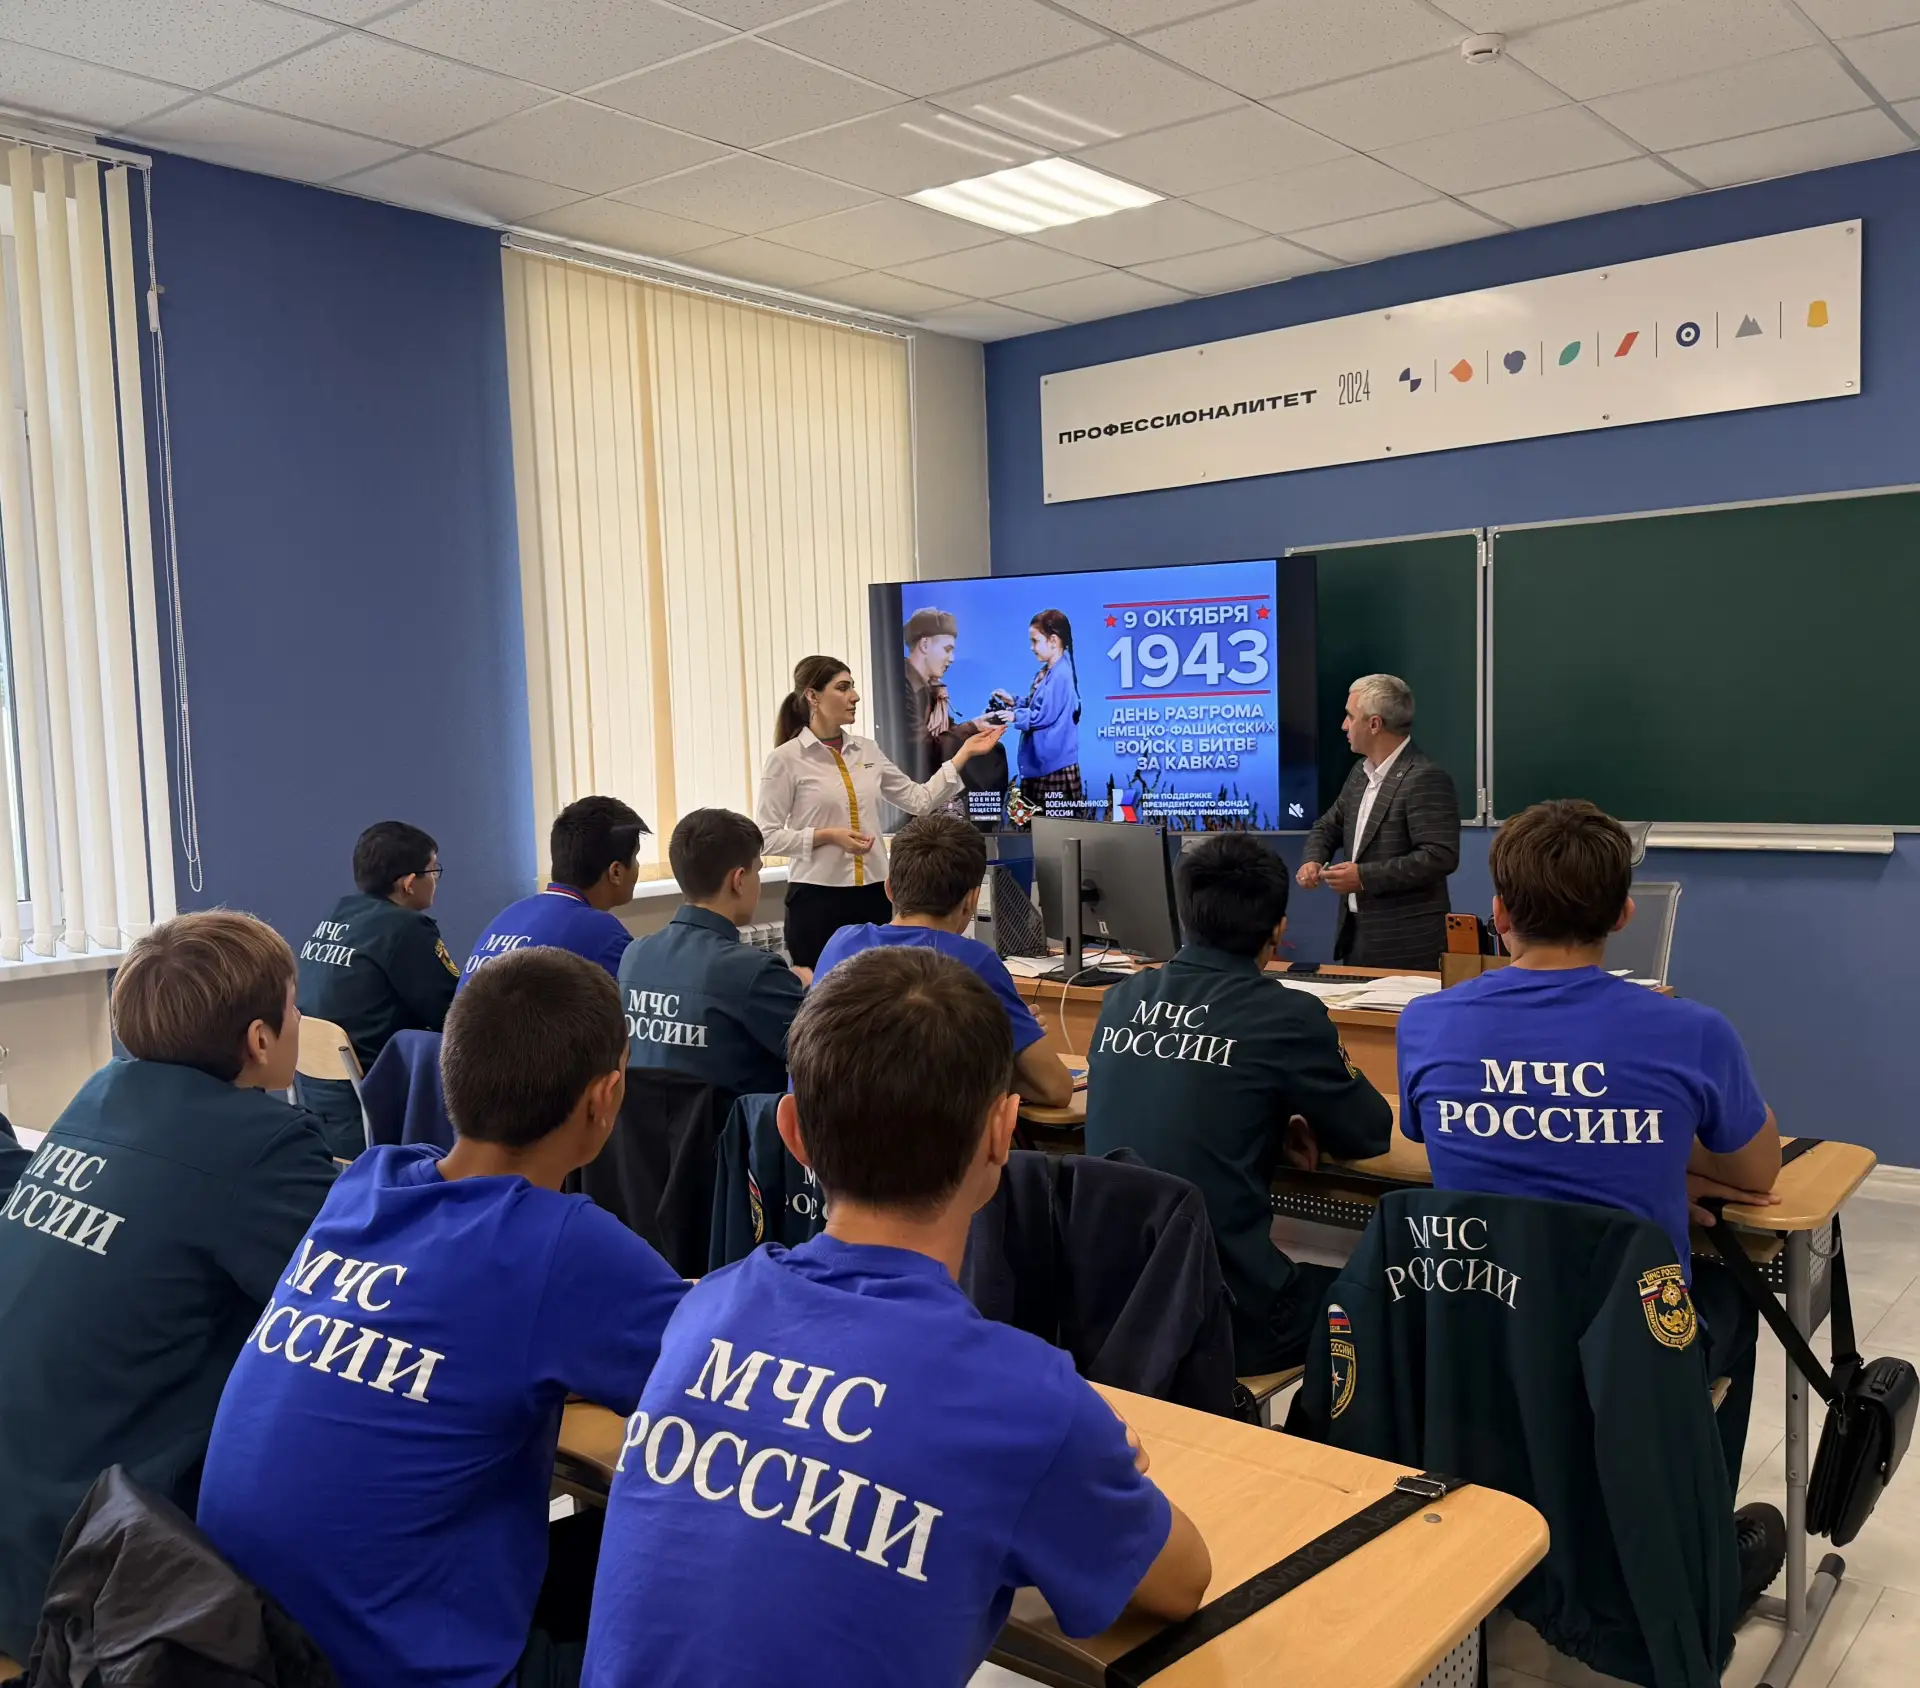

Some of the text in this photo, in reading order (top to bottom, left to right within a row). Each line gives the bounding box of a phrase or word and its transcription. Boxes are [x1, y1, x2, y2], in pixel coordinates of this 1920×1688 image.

[1058, 369, 1371, 445] ПРОФЕССИОНАЛИТЕТ 2024
[1123, 604, 1249, 628] 9 ОКТЯБРЯ
[1106, 629, 1269, 689] 1943
[1111, 704, 1264, 725] ДЕНЬ РАЗГРОМА
[1097, 720, 1276, 739] НЕМЕЦКО-ФАШИСТСКИХ
[1114, 736, 1257, 755] ВОЙСК В БИТВЕ
[1136, 754, 1239, 771] ЗА КАВКАЗ
[1045, 791, 1064, 799] КЛУБ
[1045, 799, 1109, 808] ВОЕНАЧАЛЬНИКОВ
[1142, 799, 1249, 808] ПРЕЗИДЕНТСКОГО ФОНДА
[1160, 792, 1213, 800] ПОДДЕРЖКЕ
[1045, 808, 1074, 817] РОССИИ
[1142, 808, 1250, 817] КУЛЬТУРНЫХ ИНИЦИАТИВ
[312, 920, 350, 942] МЧС
[480, 934, 532, 952] МЧС
[300, 940, 357, 968] ОССИИ
[628, 989, 680, 1018] МЧС
[1130, 1000, 1209, 1029] МЧС
[625, 1014, 708, 1048] ОССИИ
[1098, 1026, 1237, 1068] РОССИИ
[1480, 1058, 1608, 1098] МЧС
[1436, 1100, 1664, 1144] РОССИИ
[25, 1142, 108, 1192] МЧС
[0, 1179, 126, 1256] ОССИИ
[1404, 1215, 1488, 1251] МЧС
[285, 1238, 407, 1312] МЧС
[247, 1297, 445, 1403] ОССИИ
[1331, 1342, 1352, 1357] ОССИИ
[684, 1338, 887, 1443] МЧС
[615, 1410, 943, 1582] РОССИИ
